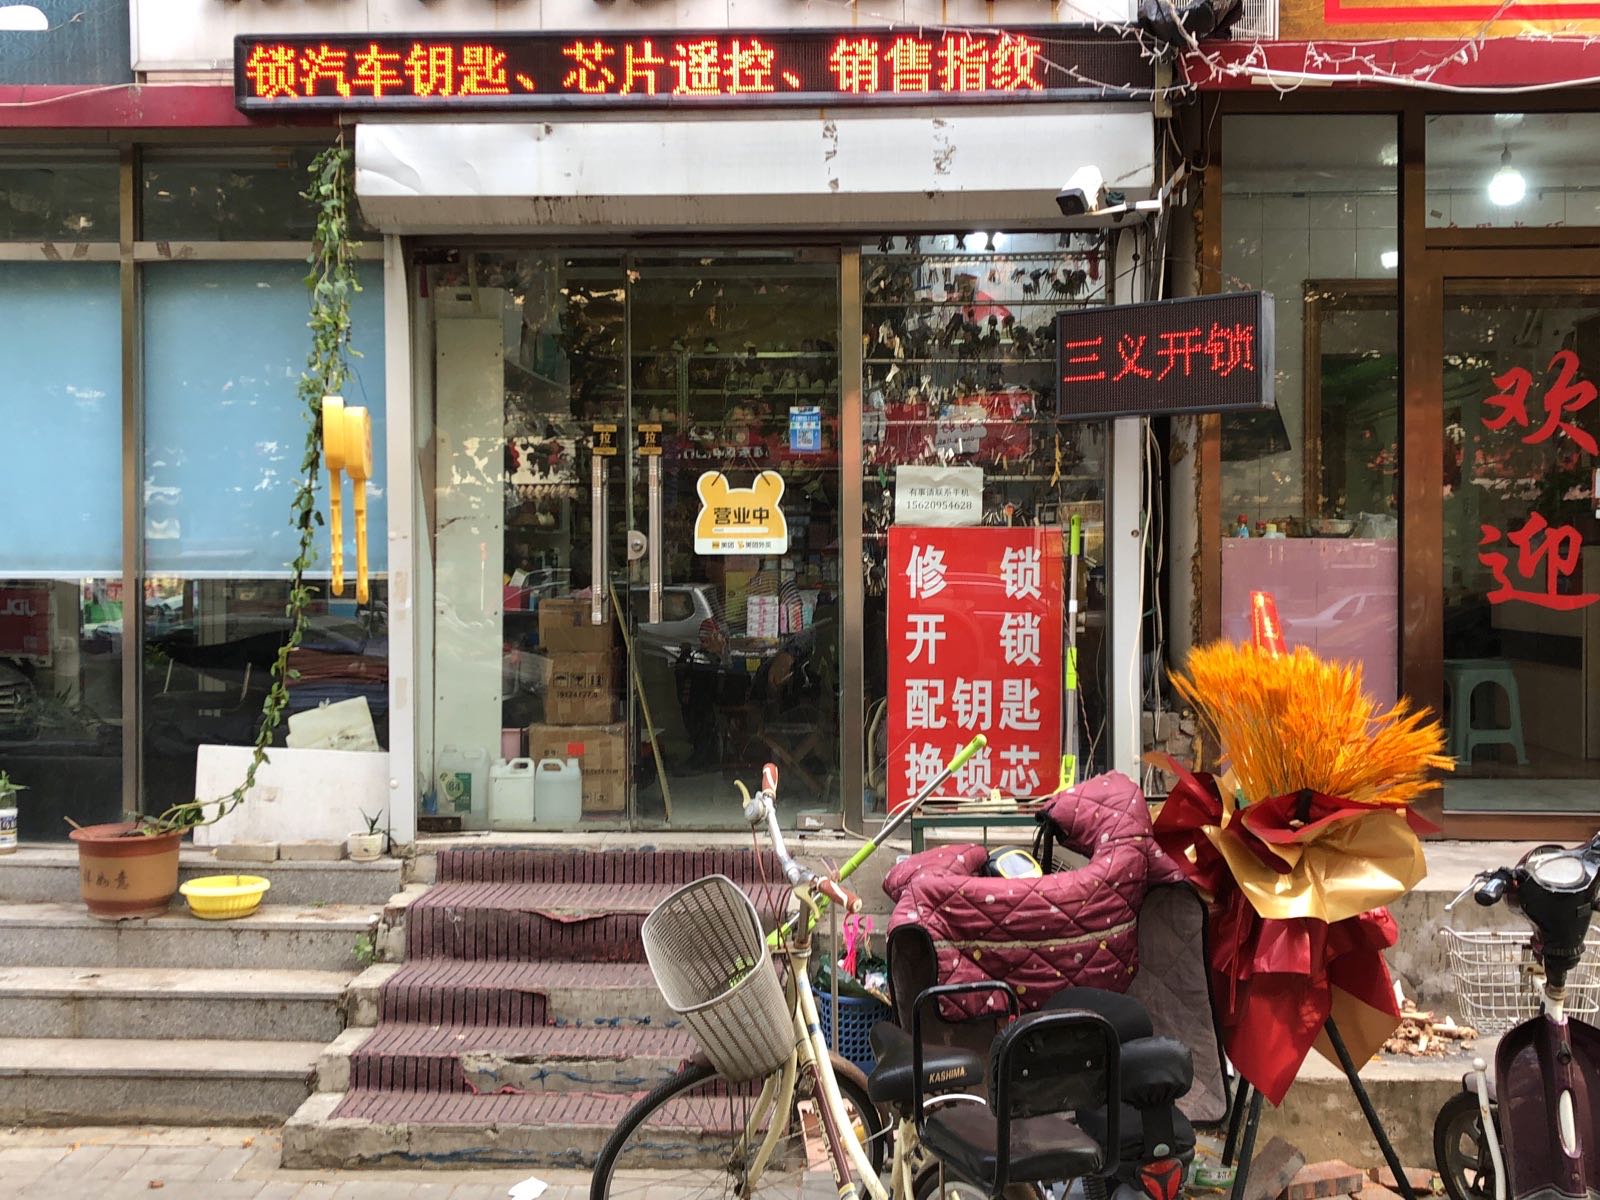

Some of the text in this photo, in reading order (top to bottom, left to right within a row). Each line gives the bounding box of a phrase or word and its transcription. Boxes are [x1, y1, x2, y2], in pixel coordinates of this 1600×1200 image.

[1064, 321, 1255, 383] 三义开锁
[600, 432, 611, 446] 拉
[645, 432, 656, 446] 拉
[909, 488, 969, 497] 有事请联系手机
[907, 501, 972, 510] 15620954628
[714, 507, 769, 525] 营业中
[906, 677, 1042, 731] 配钥匙
[905, 742, 1041, 797] 换锁芯
[929, 1066, 965, 1084] KASHIMA
